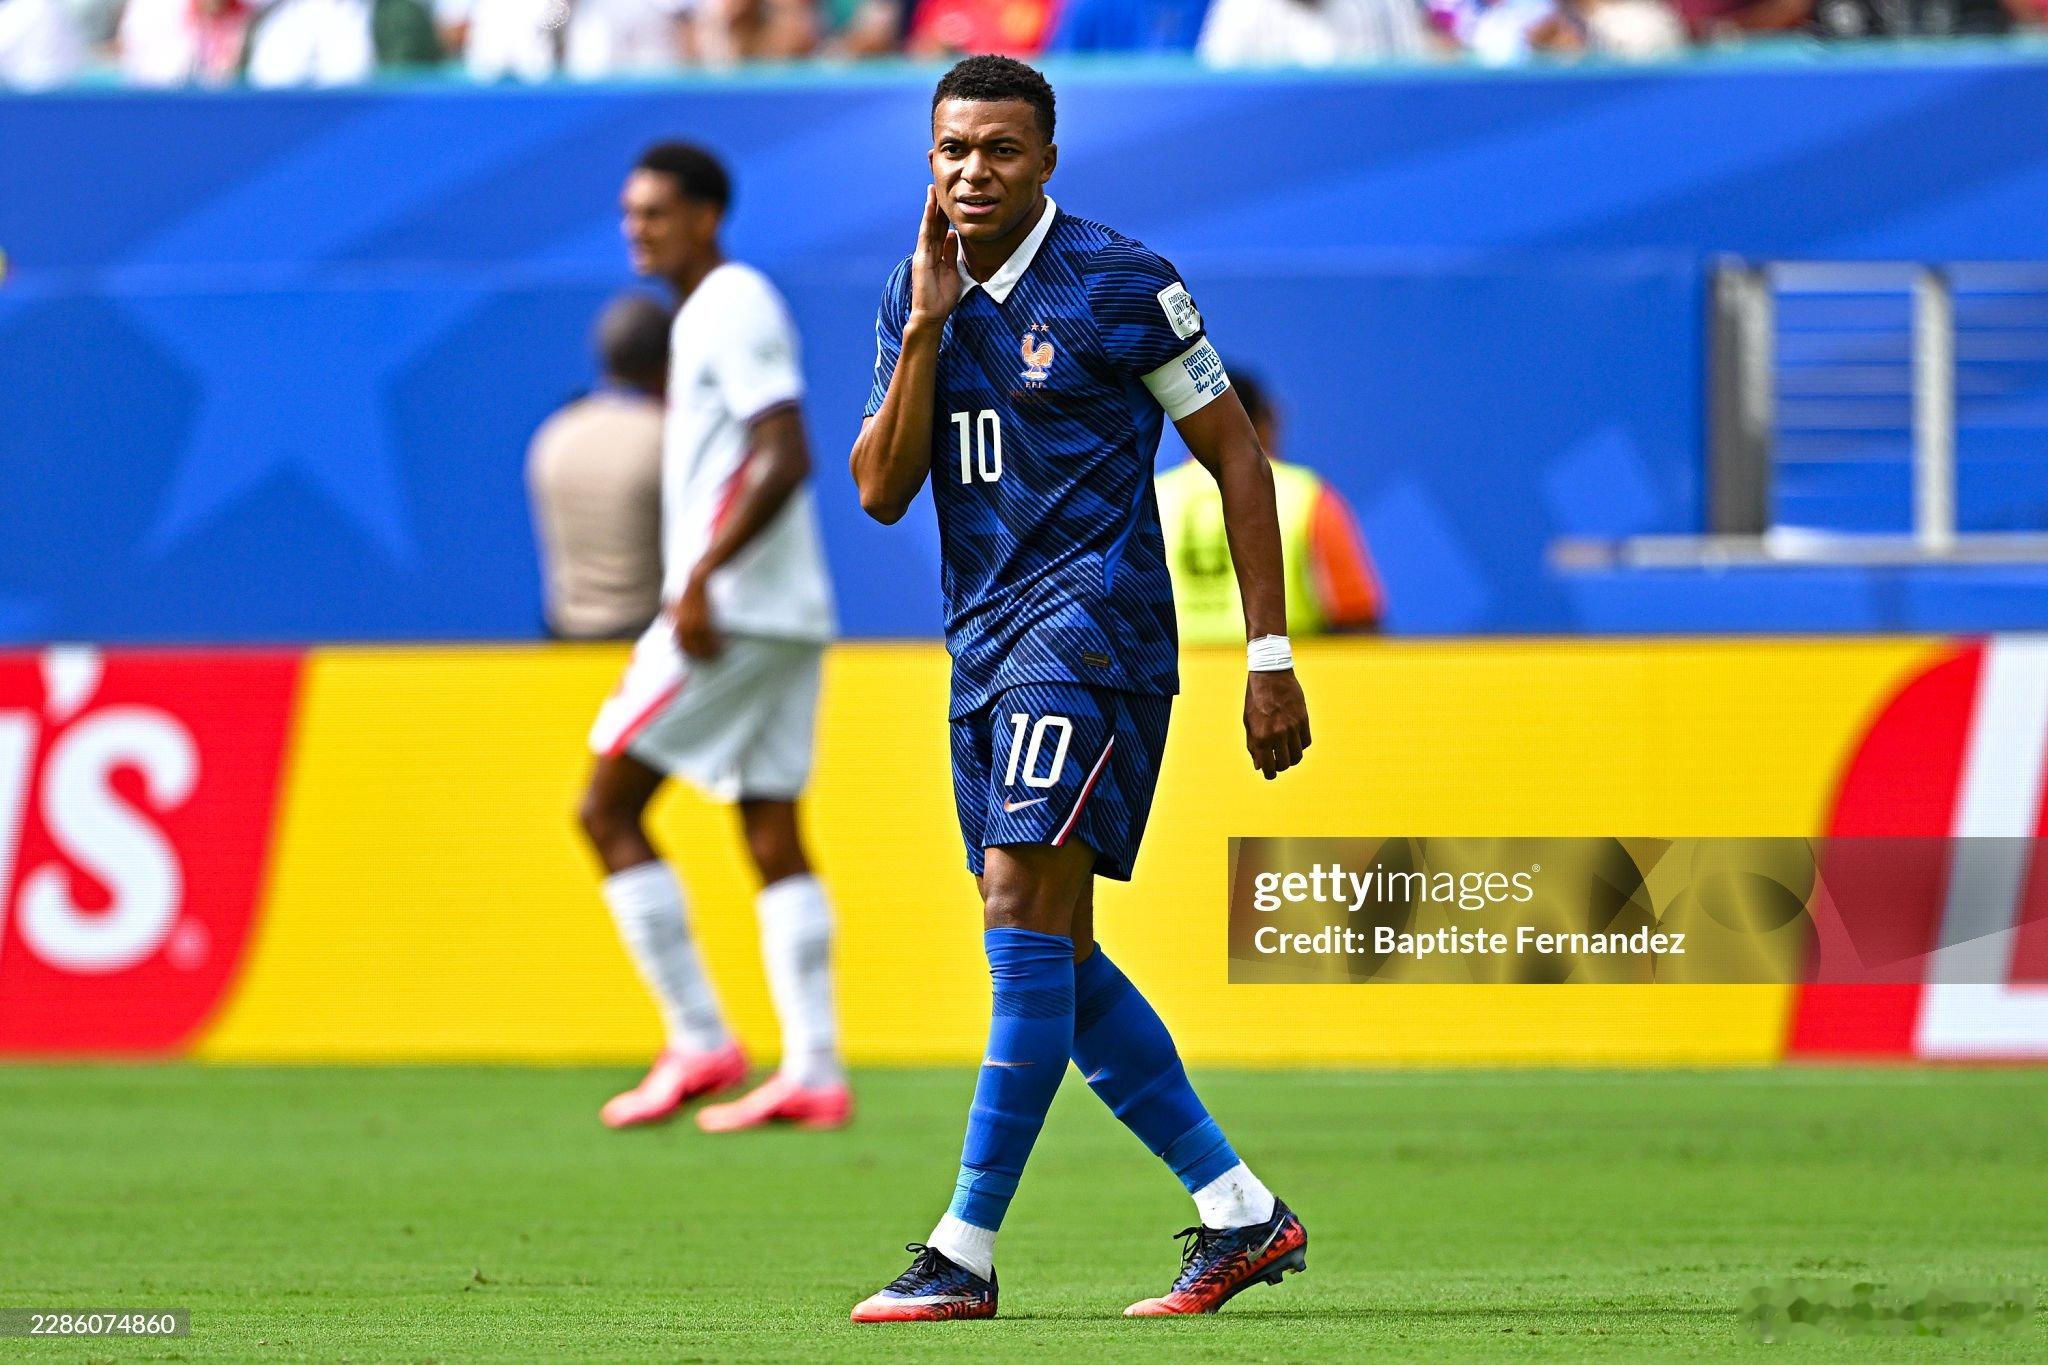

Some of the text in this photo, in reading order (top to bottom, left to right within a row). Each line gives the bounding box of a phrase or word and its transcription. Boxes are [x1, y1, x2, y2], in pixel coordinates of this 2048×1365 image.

[1172, 297, 1191, 315] UNITE
[1182, 343, 1212, 369] FOOTBALL
[1187, 351, 1220, 381] UNITES
[1193, 380, 1210, 393] the
[951, 409, 1002, 484] 10
[1005, 713, 1072, 788] 10
